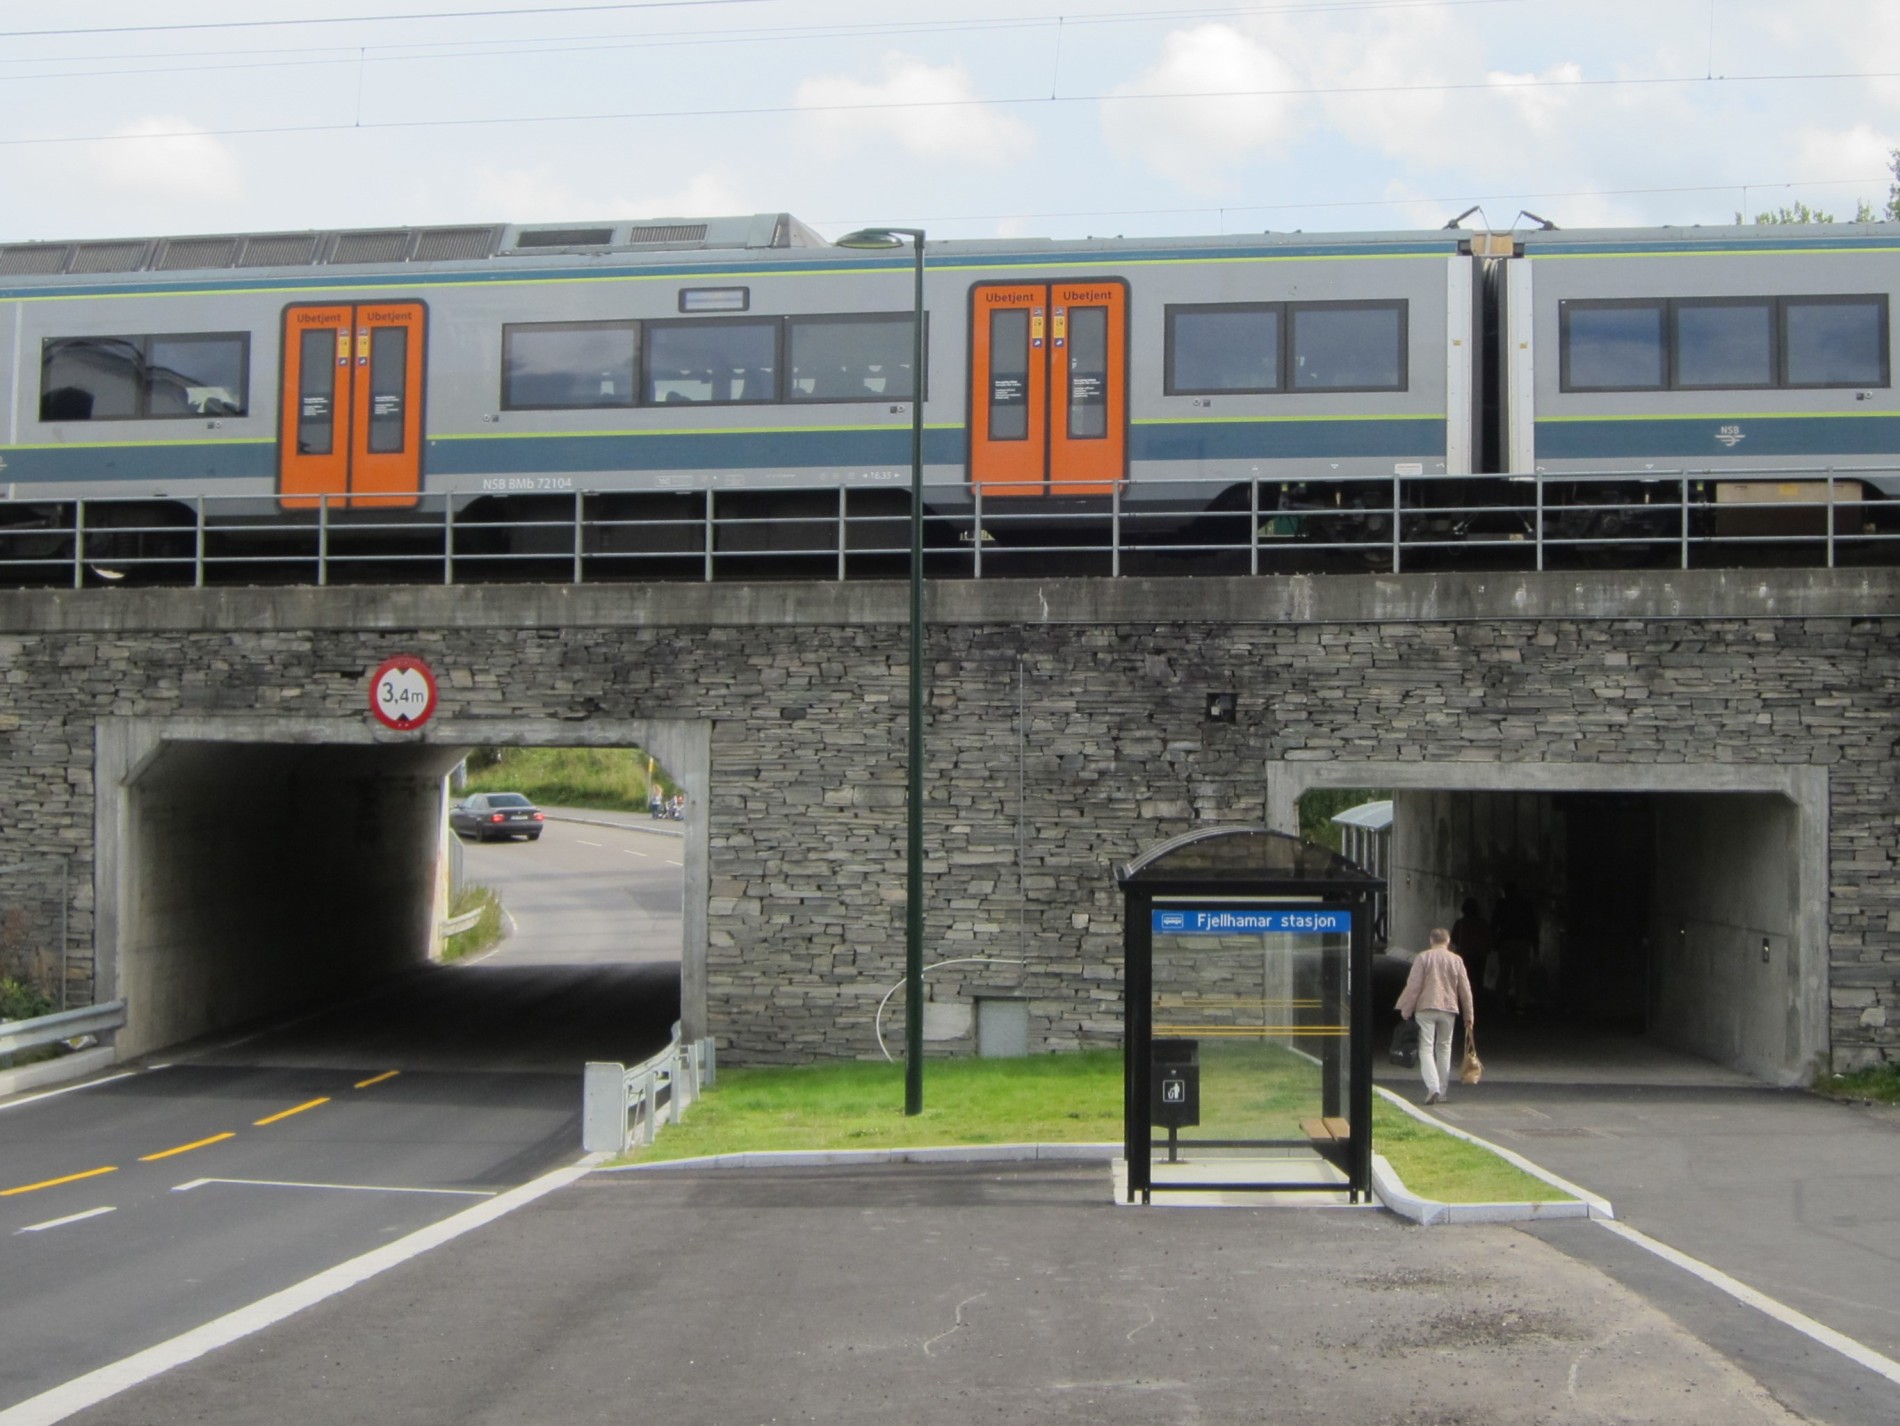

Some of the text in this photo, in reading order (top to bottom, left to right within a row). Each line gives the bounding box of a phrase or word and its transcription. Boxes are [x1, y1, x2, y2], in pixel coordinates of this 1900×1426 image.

[985, 292, 1034, 304] Ubetjent
[1063, 290, 1112, 302] Ubetjent
[297, 313, 341, 324] Ubetjent
[367, 311, 412, 323] Ubetjent
[1720, 425, 1740, 434] NSB
[483, 477, 572, 490] NSB BMb 72104
[1197, 913, 1336, 930] Fjellhamar stasjon
